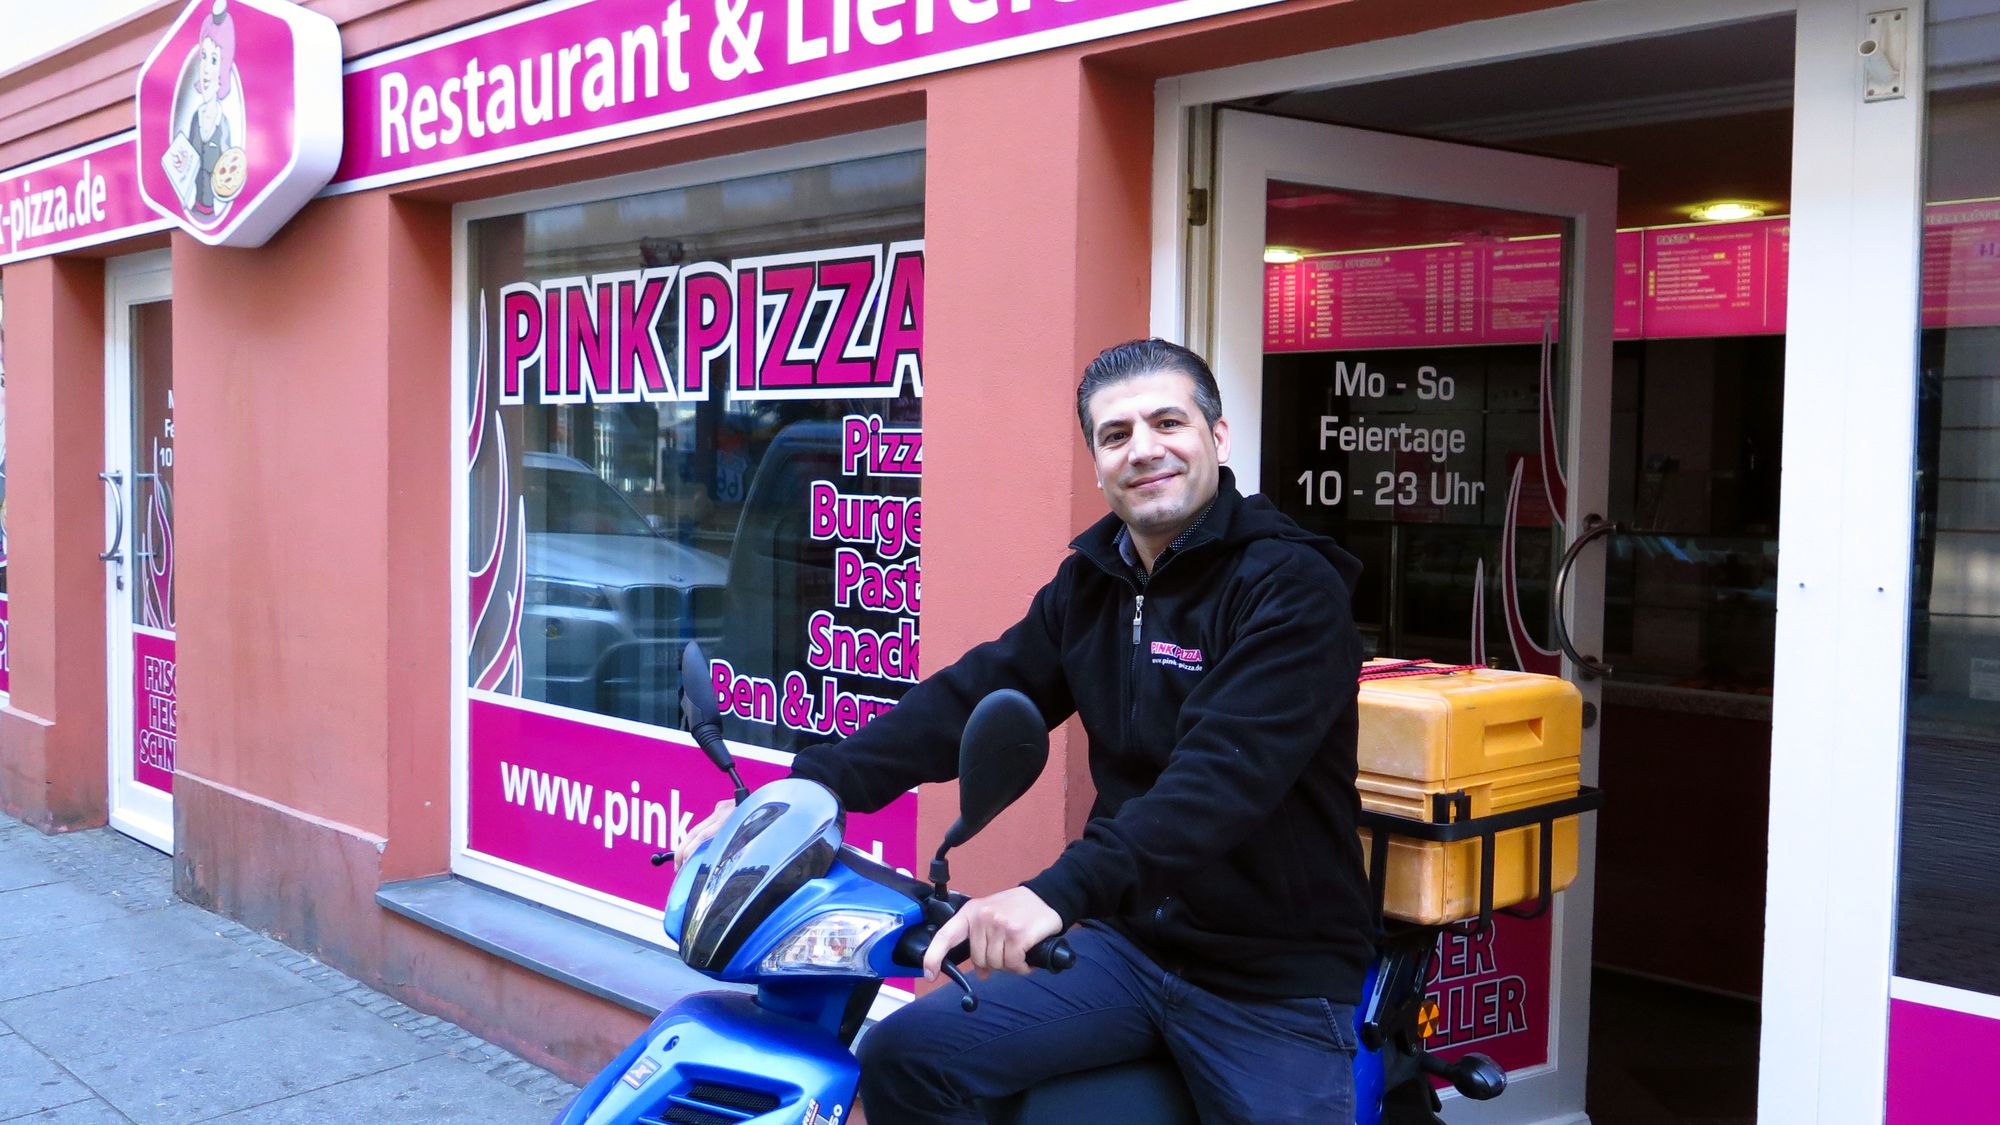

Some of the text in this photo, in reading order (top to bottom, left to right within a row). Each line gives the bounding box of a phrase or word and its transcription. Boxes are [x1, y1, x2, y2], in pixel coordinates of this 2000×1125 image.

[380, 0, 690, 158] Restaurant
[709, 0, 764, 81] &
[500, 238, 924, 405] PINK PIZZA
[1335, 361, 1386, 398] Mo
[1417, 366, 1455, 400] So
[159, 447, 173, 467] 10
[842, 413, 922, 478] Pizz
[1320, 415, 1466, 463] Feiertage
[811, 480, 921, 559] Burge
[1297, 470, 1342, 505] 10
[1375, 471, 1418, 505] 23
[1431, 472, 1485, 505] Uhr
[835, 547, 921, 616] Past
[807, 610, 920, 684] Snack
[1151, 641, 1202, 662] PINK PIZZA
[710, 659, 777, 725] Ben
[781, 670, 814, 733] &
